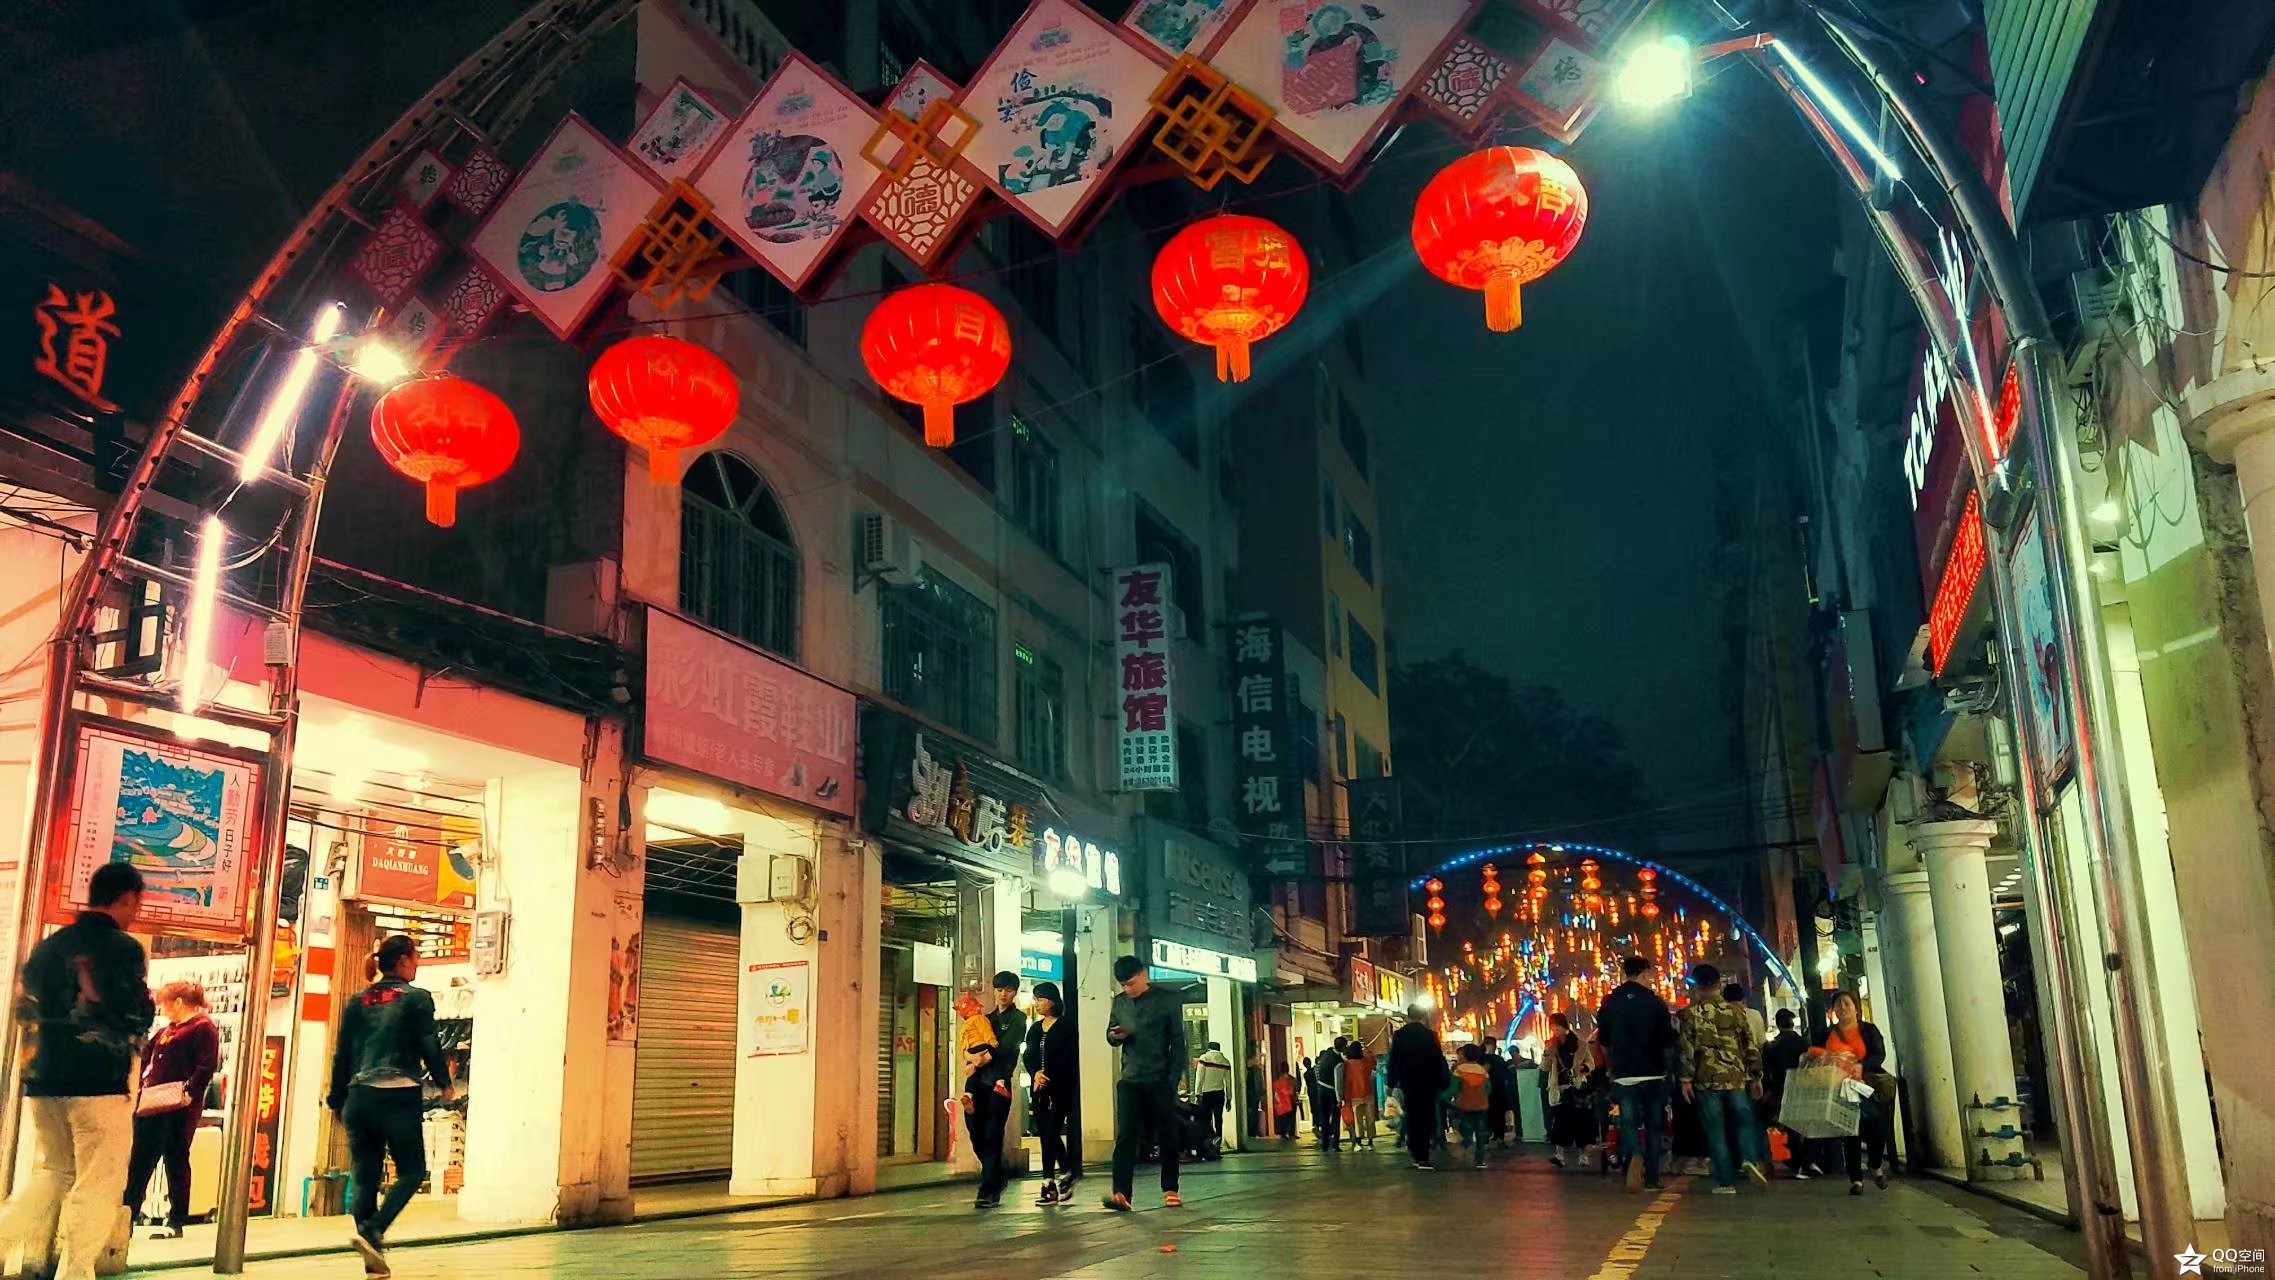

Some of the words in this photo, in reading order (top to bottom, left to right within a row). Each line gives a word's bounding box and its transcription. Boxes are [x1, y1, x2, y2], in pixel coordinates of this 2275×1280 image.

[34, 281, 121, 413] 道
[1118, 571, 1169, 733] 友华旅馆
[1235, 625, 1281, 815] 海信电视
[371, 857, 429, 876] DAQIANHUANG
